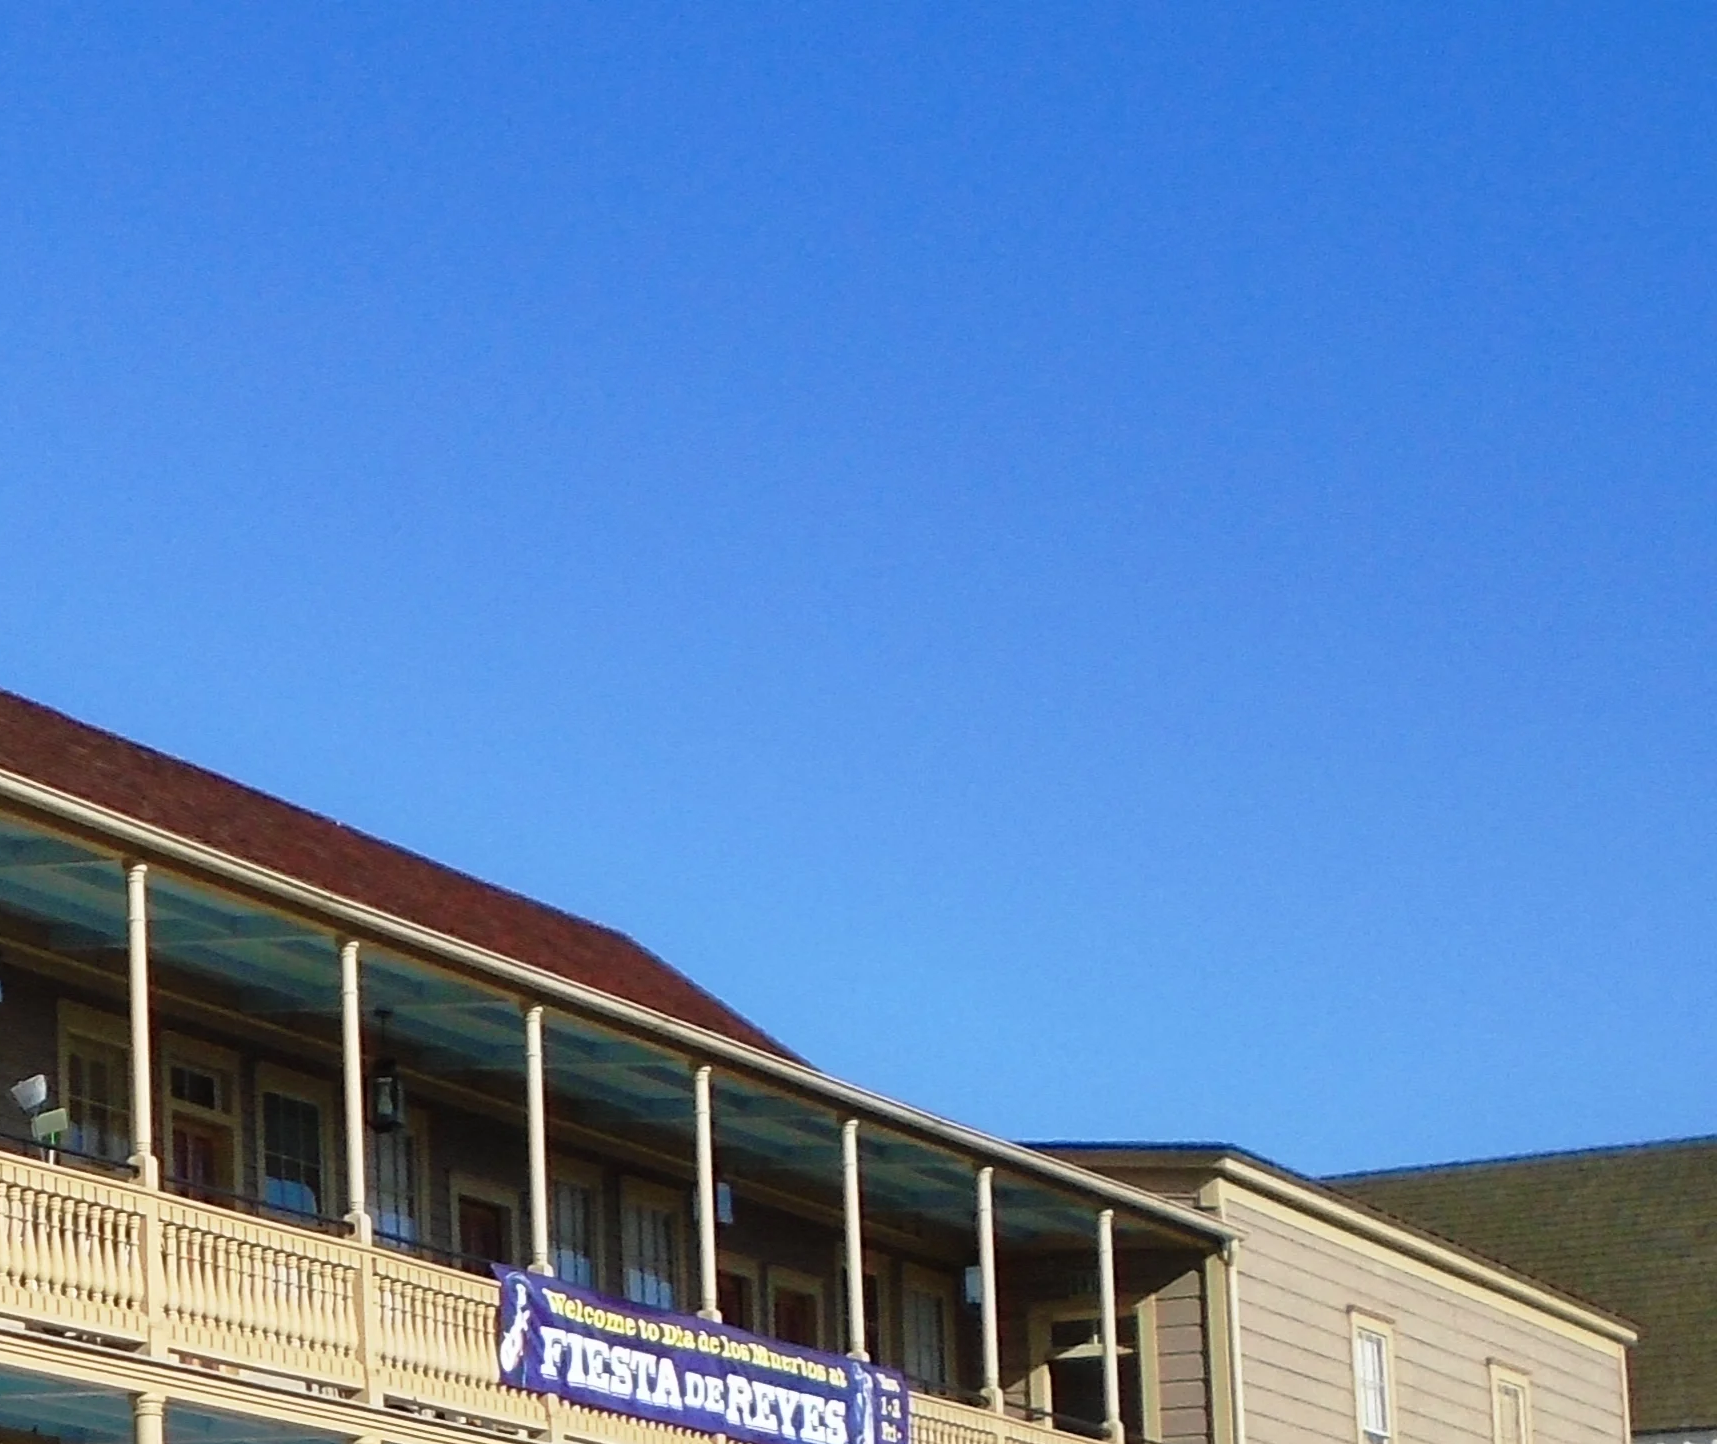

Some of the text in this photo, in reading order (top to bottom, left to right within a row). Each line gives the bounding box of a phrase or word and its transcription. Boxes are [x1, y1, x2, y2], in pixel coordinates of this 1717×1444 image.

[540, 1326, 684, 1411] FIESTA
[685, 1371, 725, 1414] DE
[542, 1288, 636, 1336] Welcome
[638, 1319, 660, 1341] to
[698, 1331, 721, 1354] de
[720, 1335, 750, 1361] los
[748, 1343, 826, 1382] Muertos
[828, 1366, 848, 1388] at
